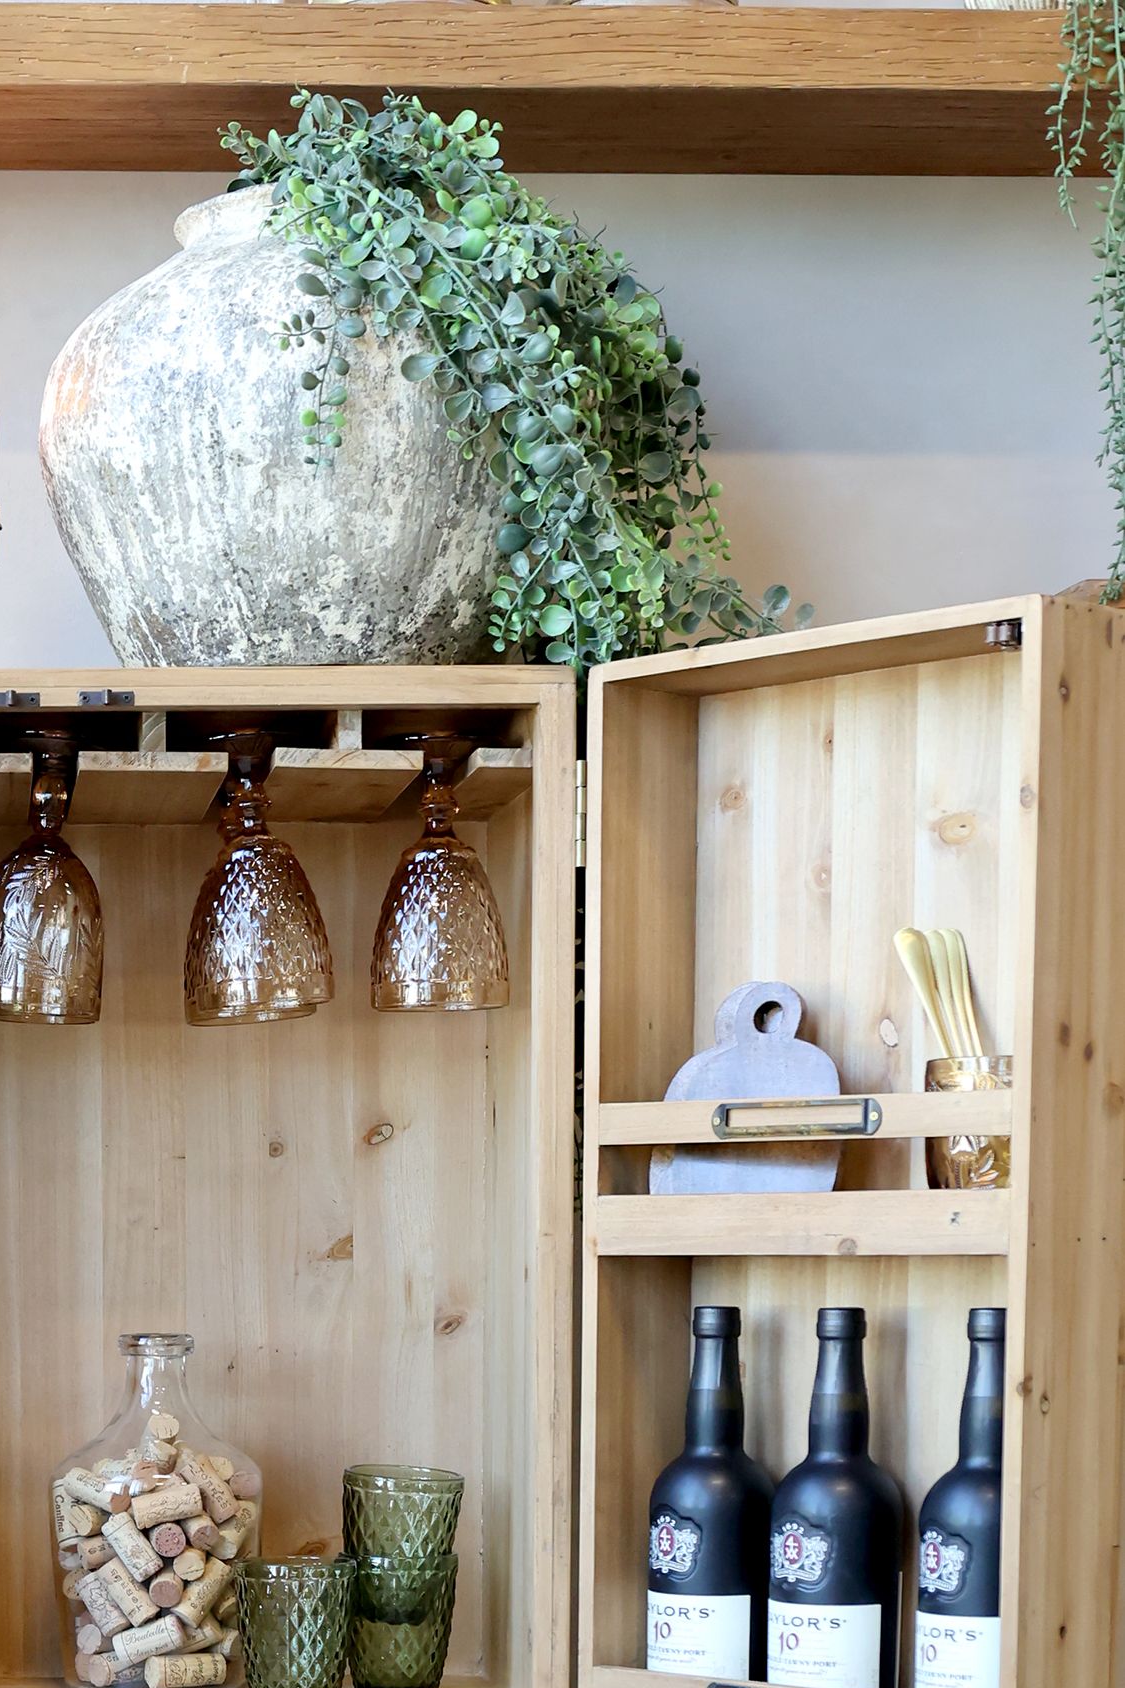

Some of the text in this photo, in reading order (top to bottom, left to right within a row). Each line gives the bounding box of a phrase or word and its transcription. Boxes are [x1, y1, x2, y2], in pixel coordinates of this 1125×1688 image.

[653, 1620, 672, 1643] 10
[779, 1632, 799, 1655] 10
[920, 1643, 938, 1667] 10
